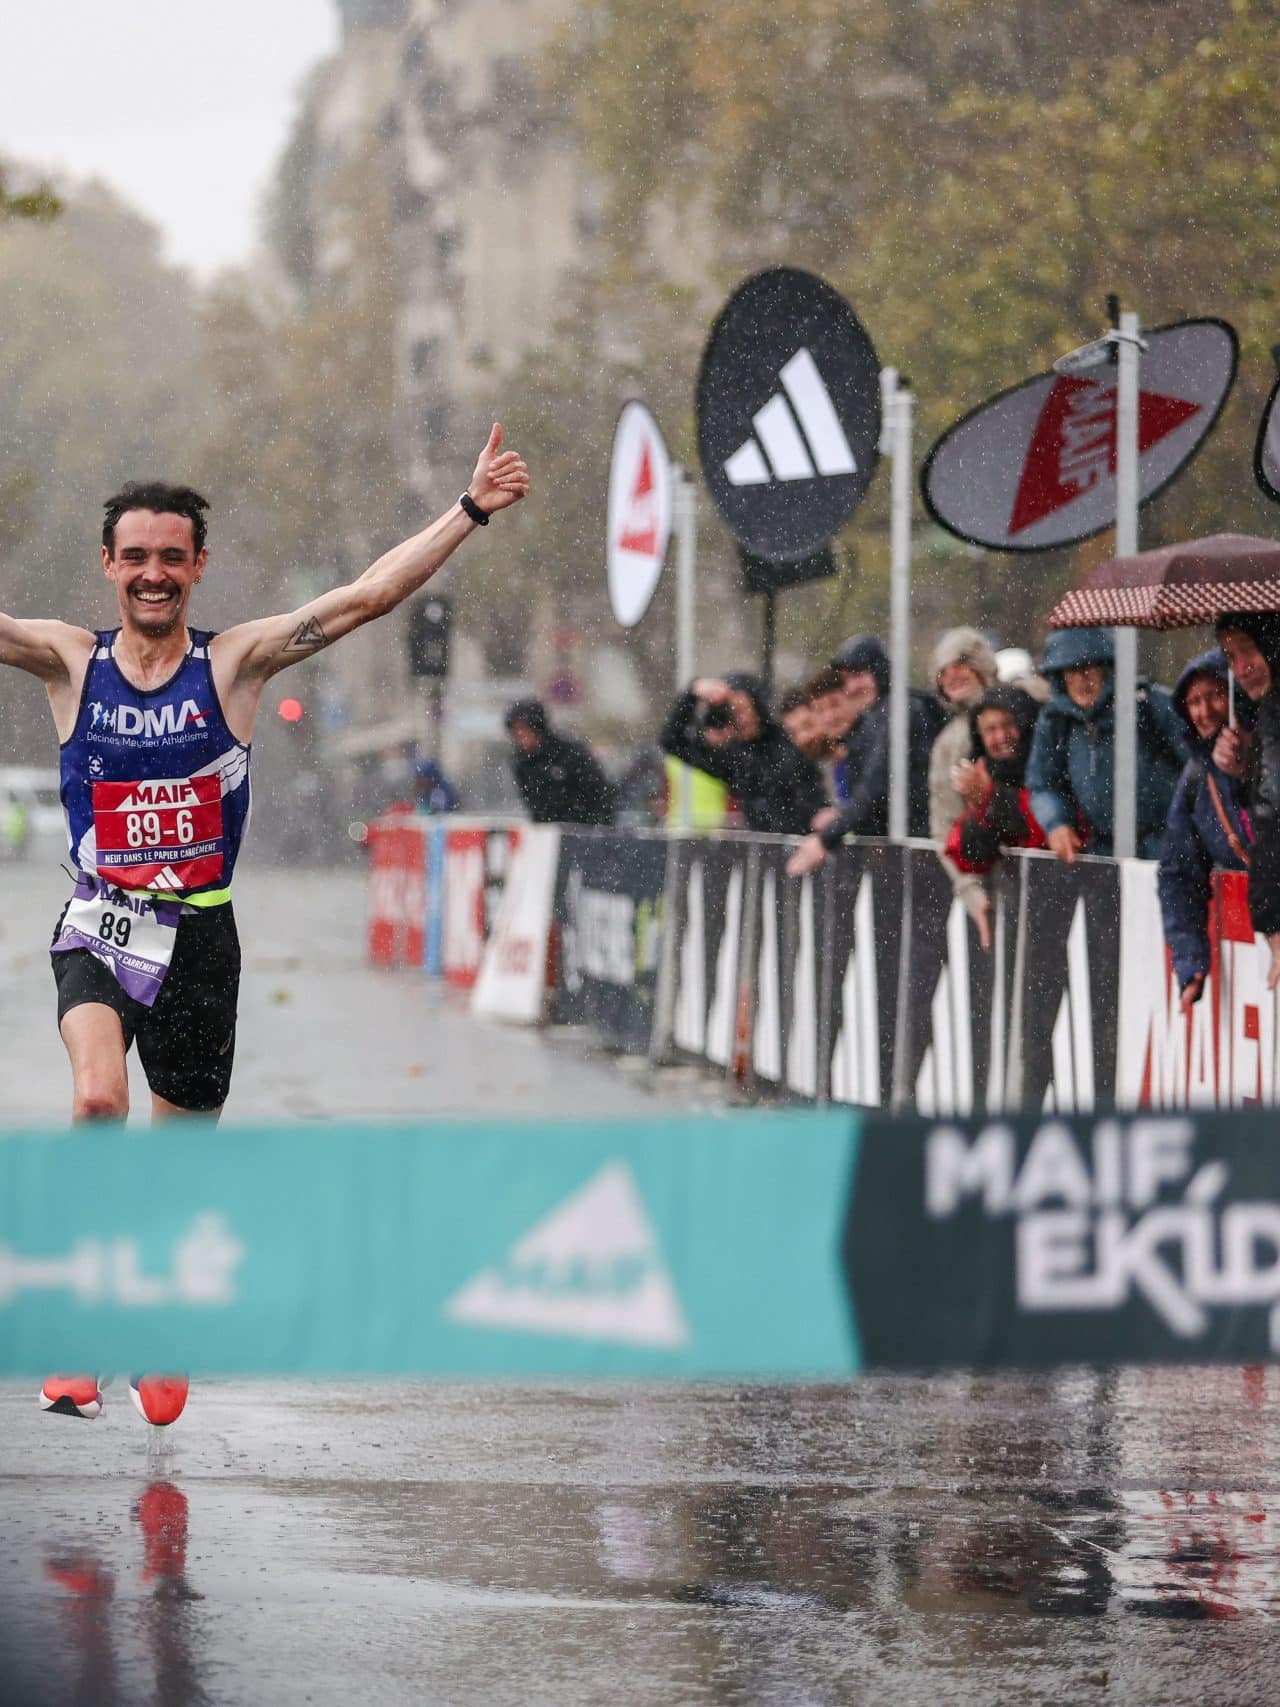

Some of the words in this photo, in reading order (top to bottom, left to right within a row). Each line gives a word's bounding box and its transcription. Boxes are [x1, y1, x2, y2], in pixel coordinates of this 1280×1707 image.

[117, 698, 207, 738] DMA
[86, 731, 120, 745] Décines
[122, 737, 160, 749] Meyzieu
[131, 784, 193, 806] MAIF
[126, 809, 194, 848] 89-6
[104, 854, 122, 864] NEUF
[123, 852, 143, 863] DANS
[144, 851, 153, 861] LE
[153, 849, 179, 861] PAPIER
[98, 912, 132, 948] 89
[924, 1116, 1195, 1218] MAIF
